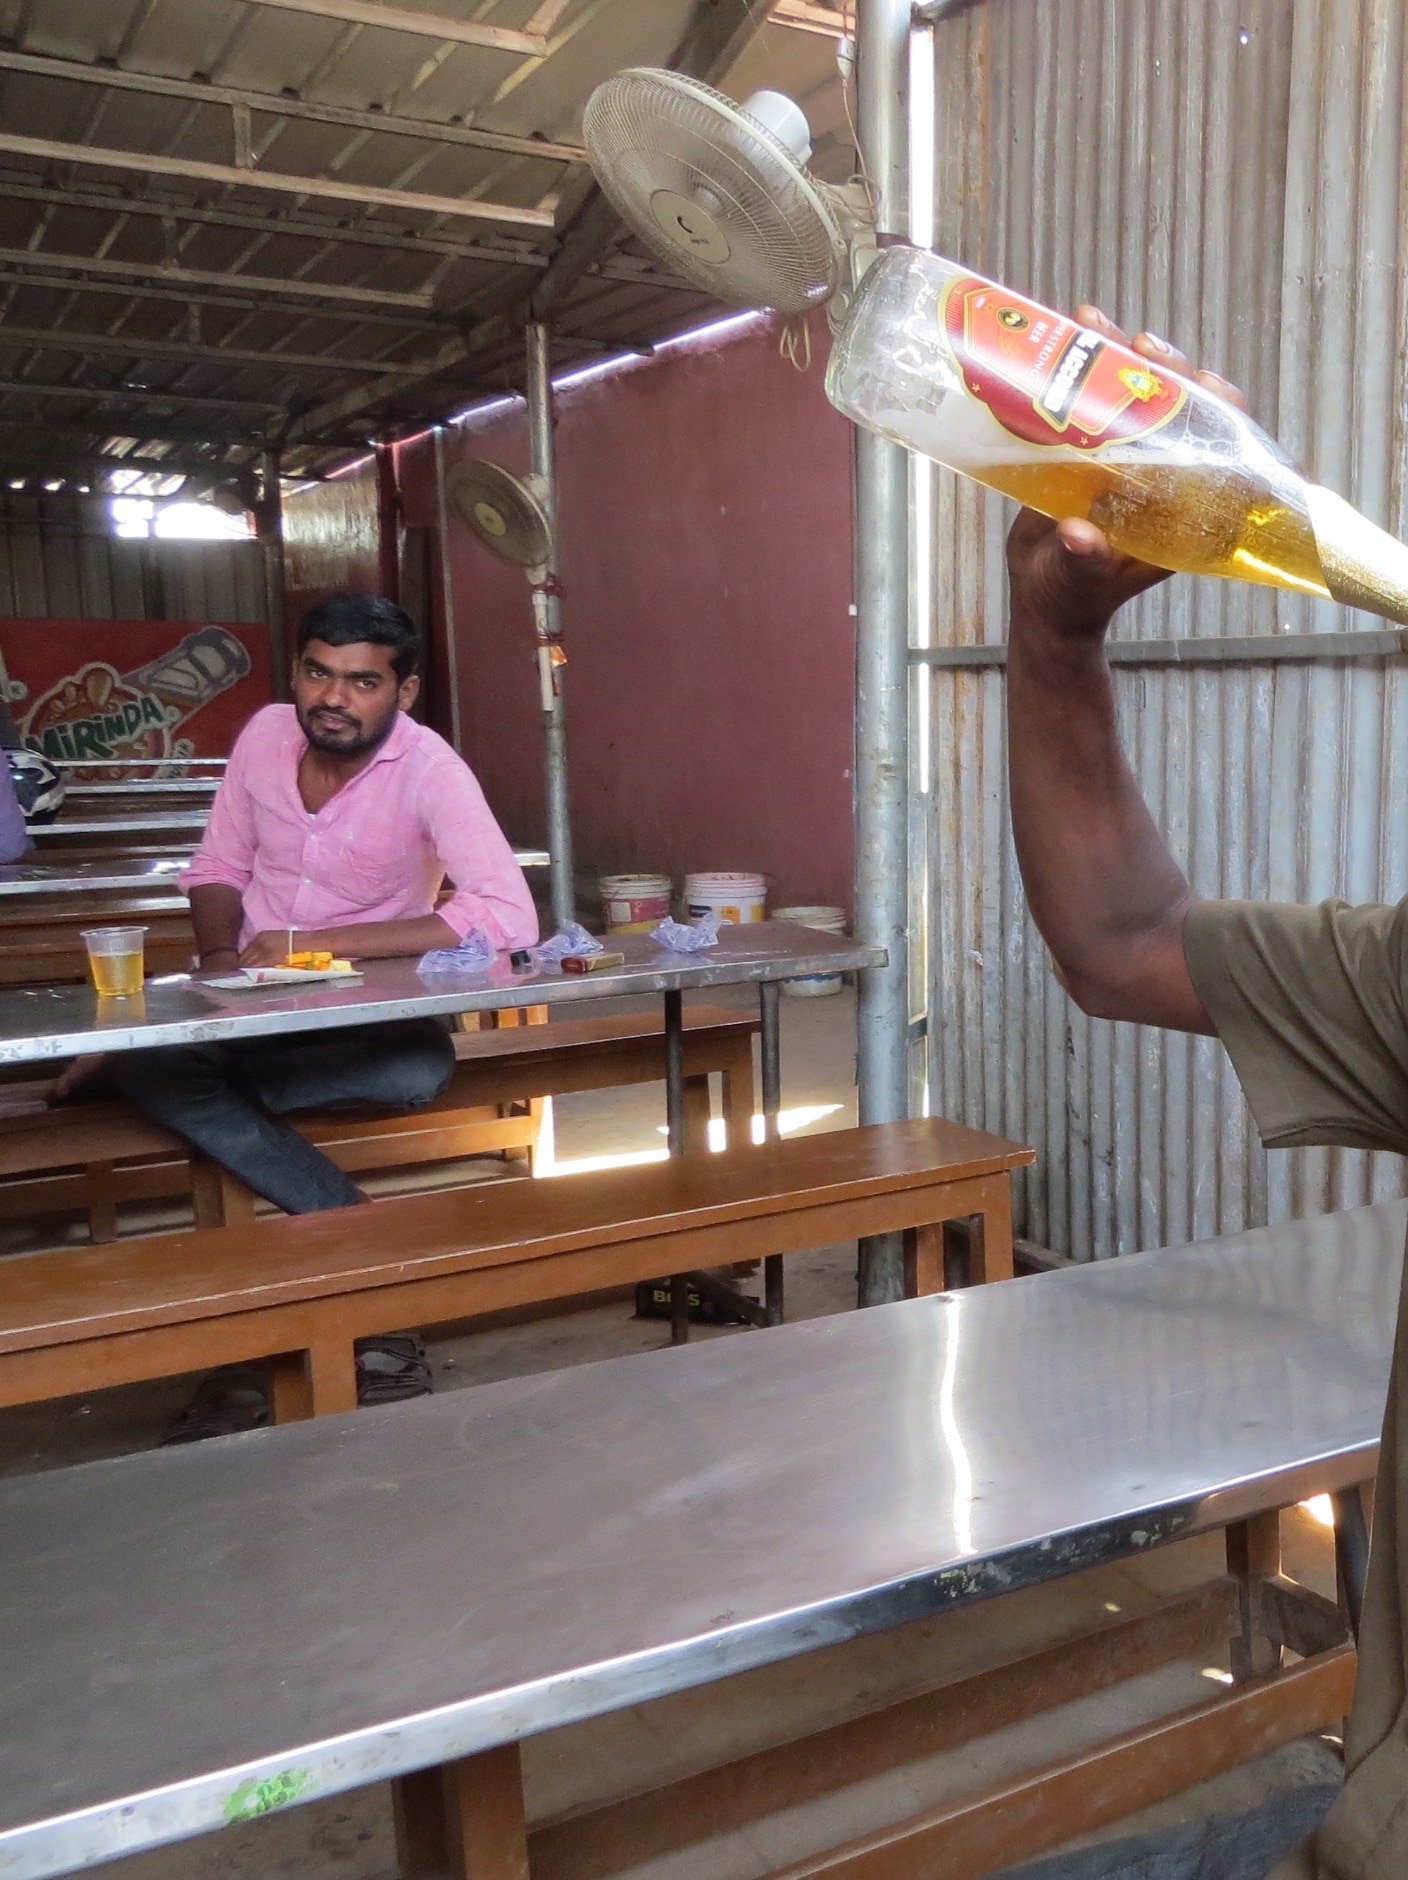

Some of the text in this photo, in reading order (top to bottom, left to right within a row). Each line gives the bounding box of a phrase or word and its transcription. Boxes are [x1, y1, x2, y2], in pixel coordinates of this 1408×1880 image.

[1028, 320, 1049, 343] BEER
[1028, 333, 1060, 380] STRONG
[1043, 345, 1089, 413] ACCORD
